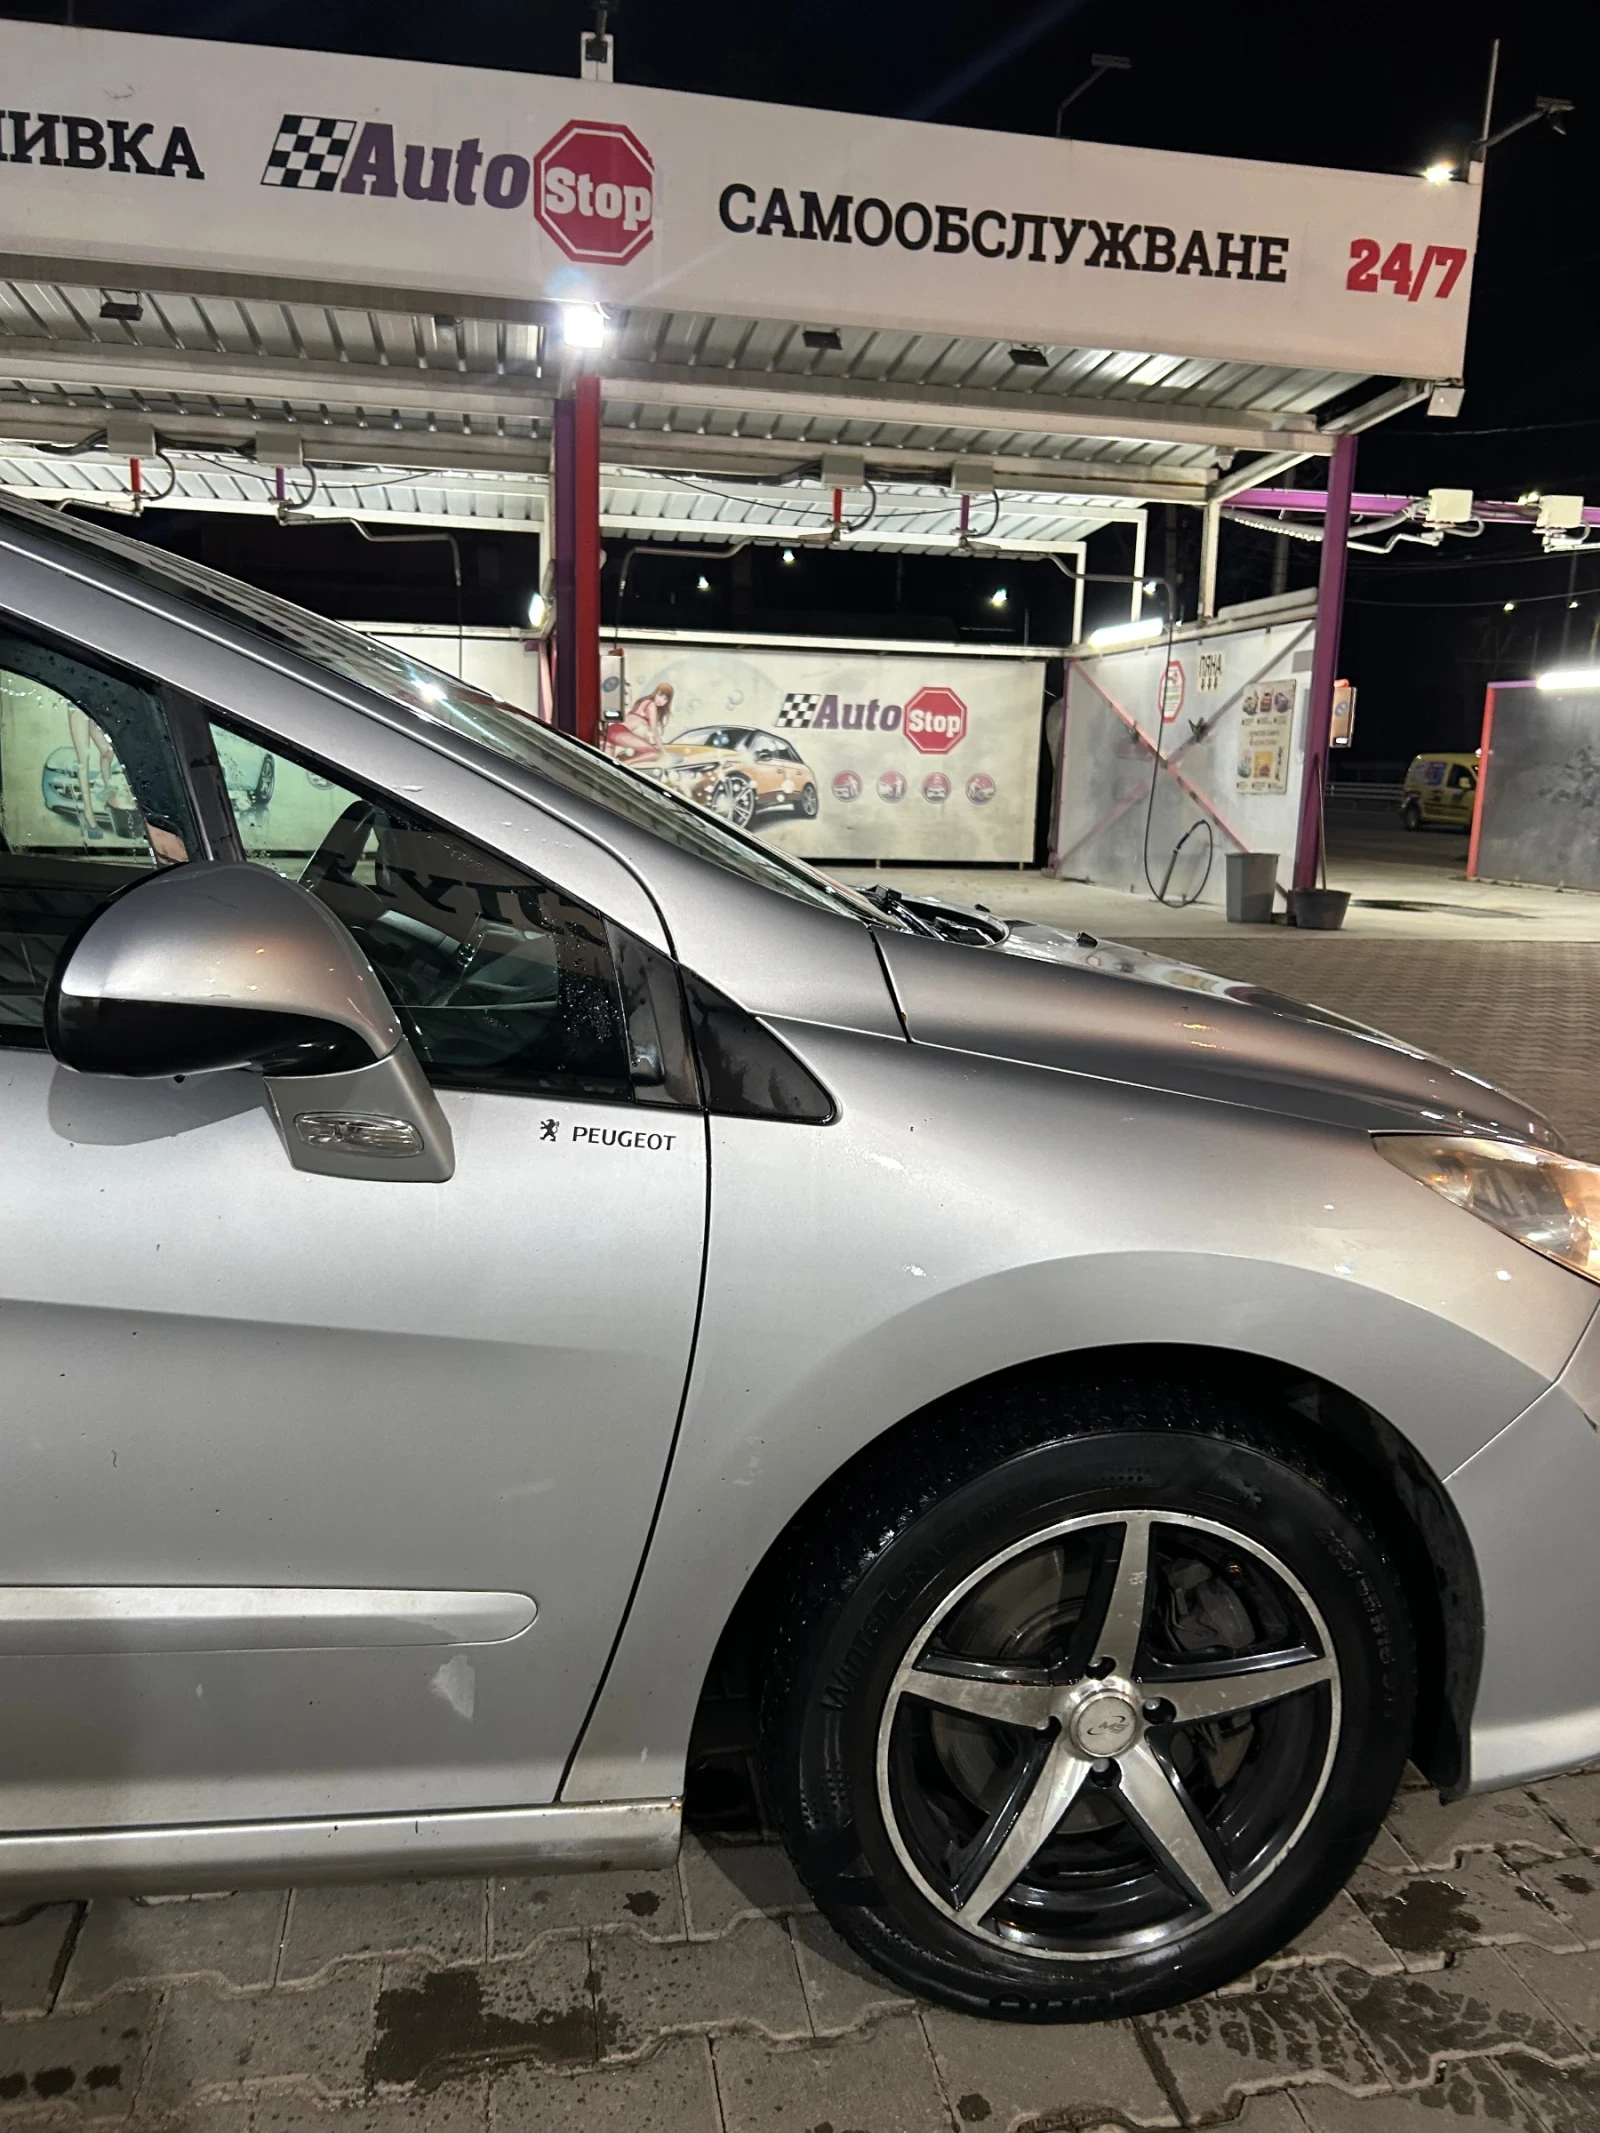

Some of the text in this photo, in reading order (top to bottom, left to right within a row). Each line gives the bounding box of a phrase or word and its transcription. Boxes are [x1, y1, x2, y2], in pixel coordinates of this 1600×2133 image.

[0, 109, 206, 180] ИВКА
[339, 121, 652, 231] Auto Stop
[718, 183, 1290, 282] САМООБСЛУЖВАНЕ
[1346, 238, 1468, 303] 24/7
[812, 694, 962, 738] Auto Stop
[572, 1126, 676, 1151] PEUGEOT
